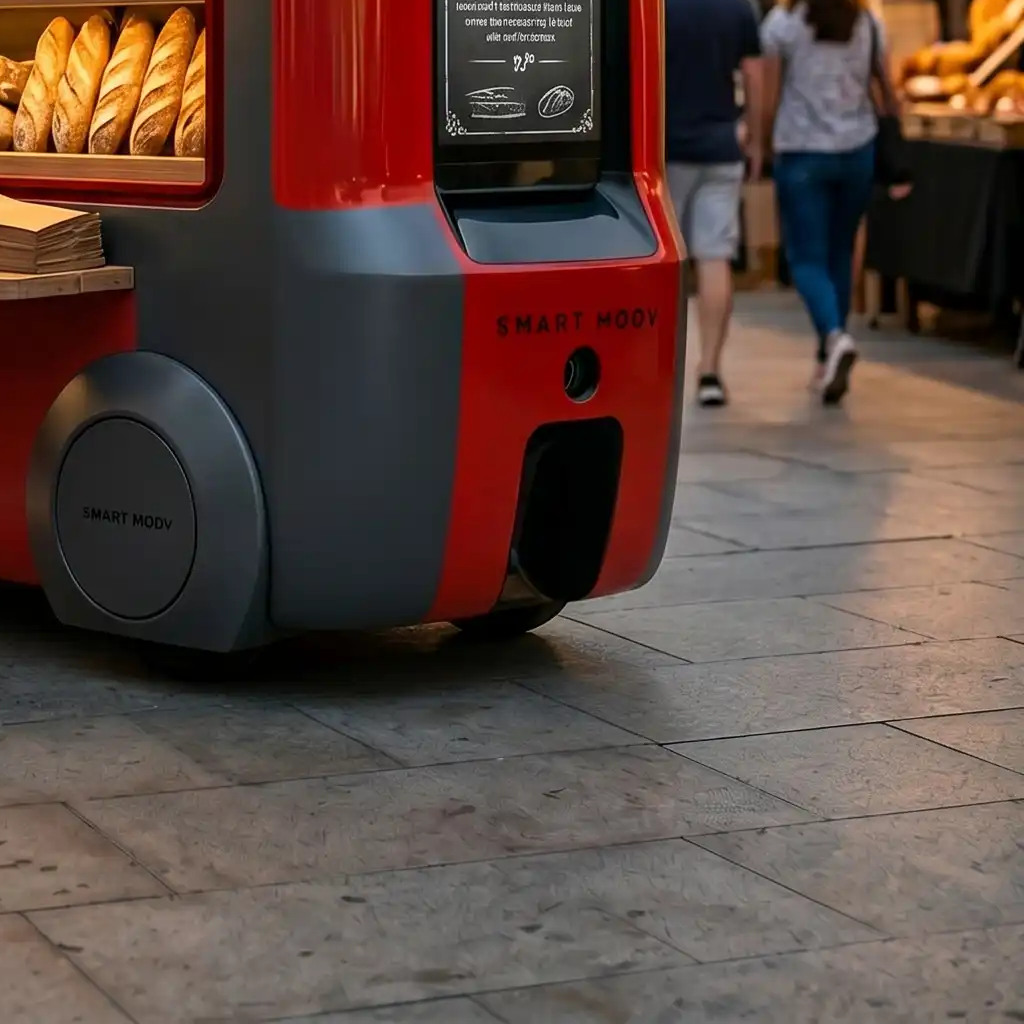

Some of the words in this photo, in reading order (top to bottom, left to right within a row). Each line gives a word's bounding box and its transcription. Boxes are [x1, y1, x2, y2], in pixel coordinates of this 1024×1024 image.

[496, 312, 583, 337] SMART
[597, 308, 658, 329] MOOV
[83, 506, 128, 525] SMART
